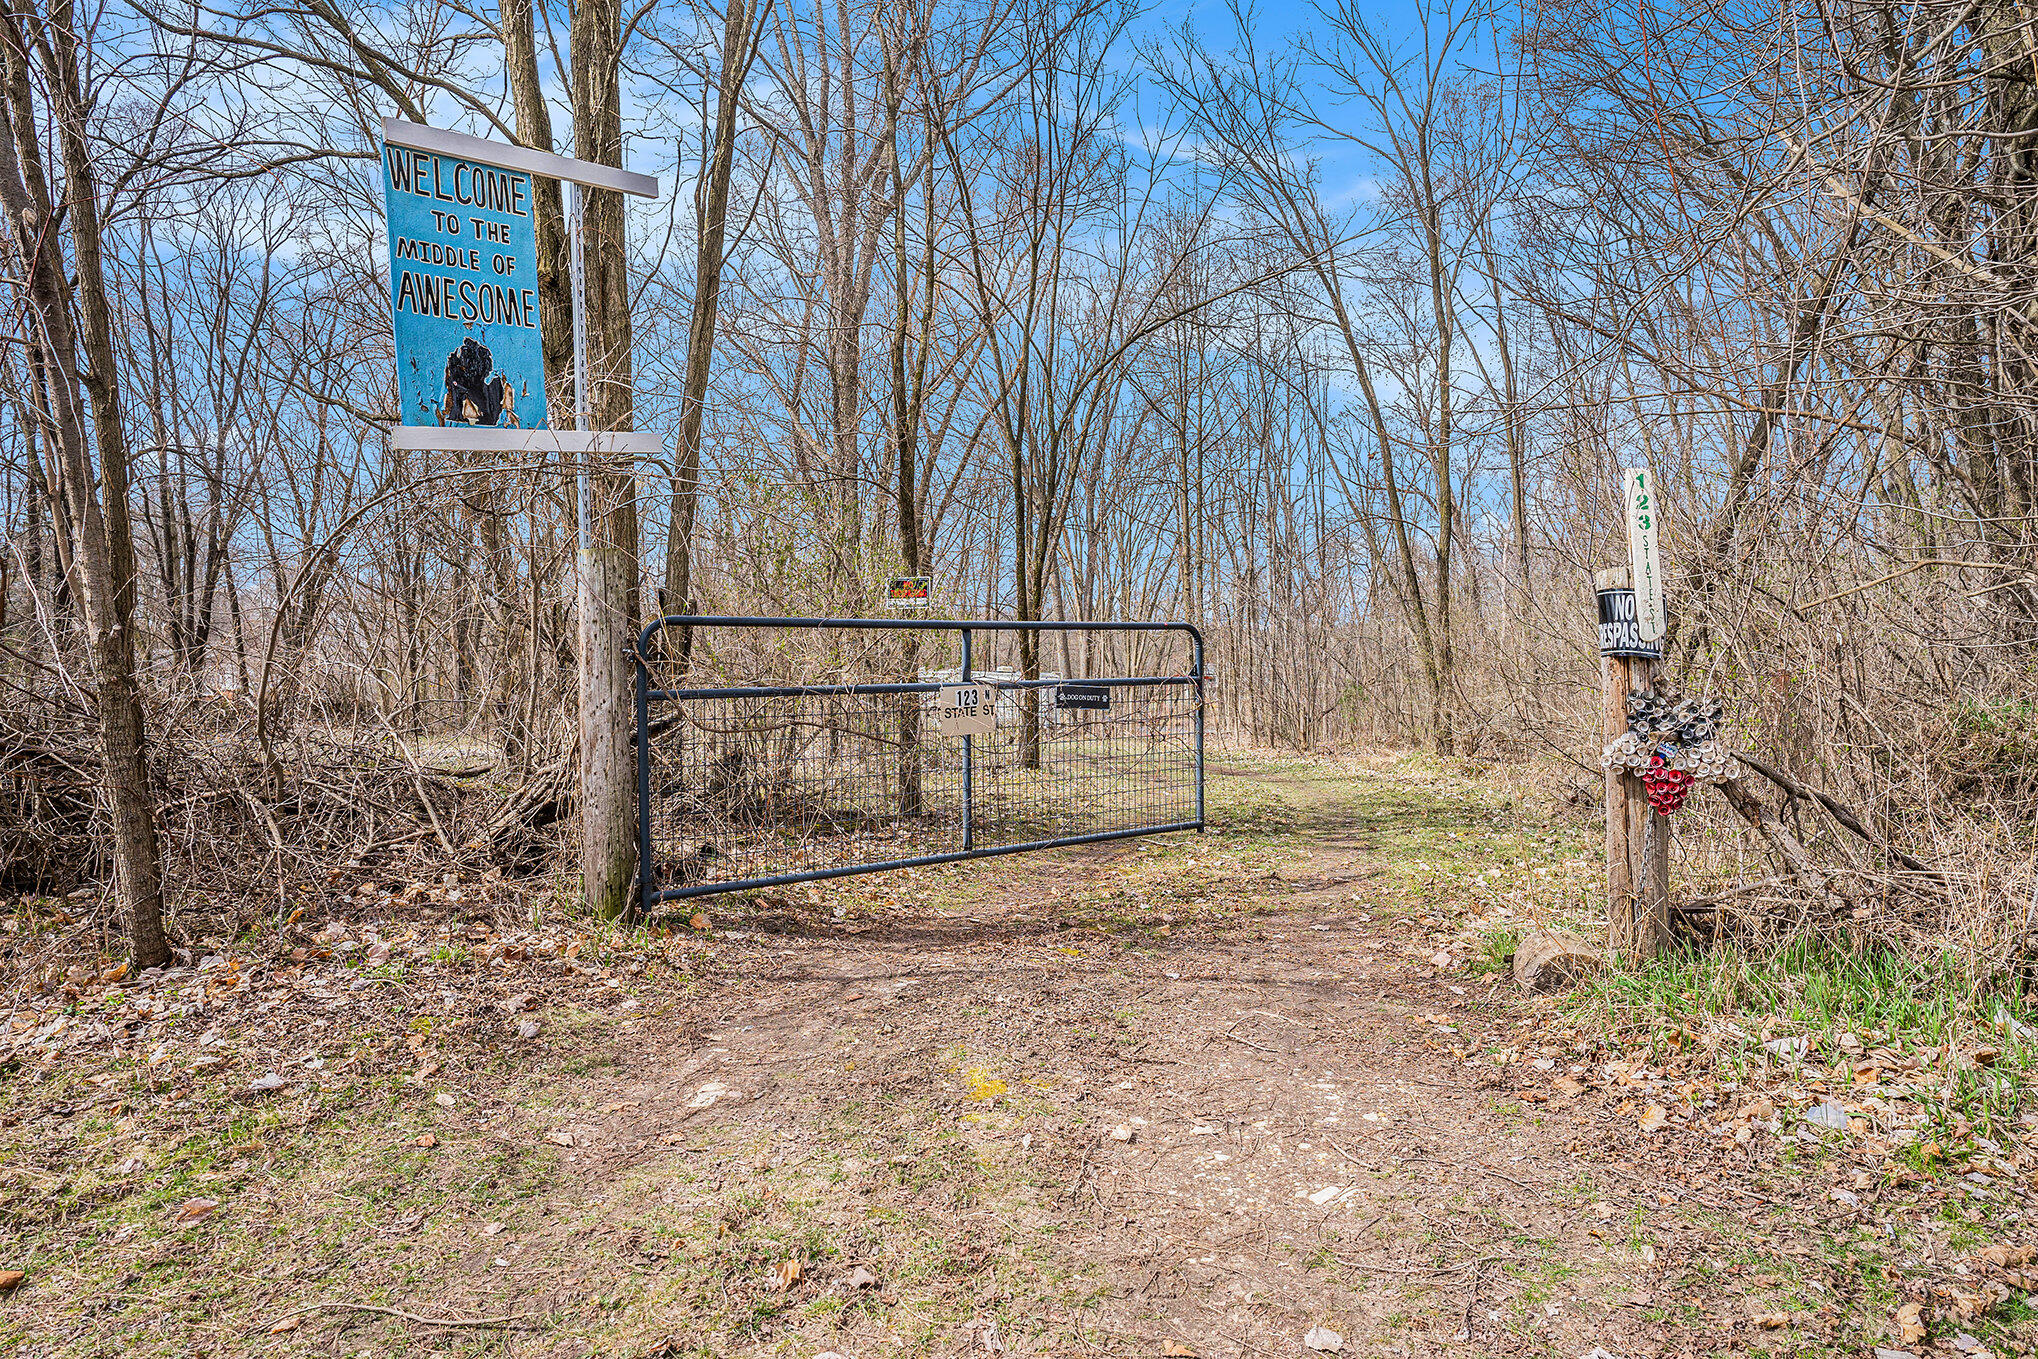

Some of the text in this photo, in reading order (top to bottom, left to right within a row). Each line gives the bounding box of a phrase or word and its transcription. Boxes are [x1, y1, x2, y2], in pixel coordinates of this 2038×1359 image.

[387, 147, 528, 217] WELCOME
[431, 209, 511, 245] TO THE
[396, 236, 516, 276] MIDDLE OF
[397, 271, 536, 328] AWESOME
[1636, 473, 1650, 531] 123
[1642, 534, 1653, 601] STATE
[1614, 594, 1635, 621] NO
[944, 705, 977, 719] STATE
[957, 689, 978, 707] 123
